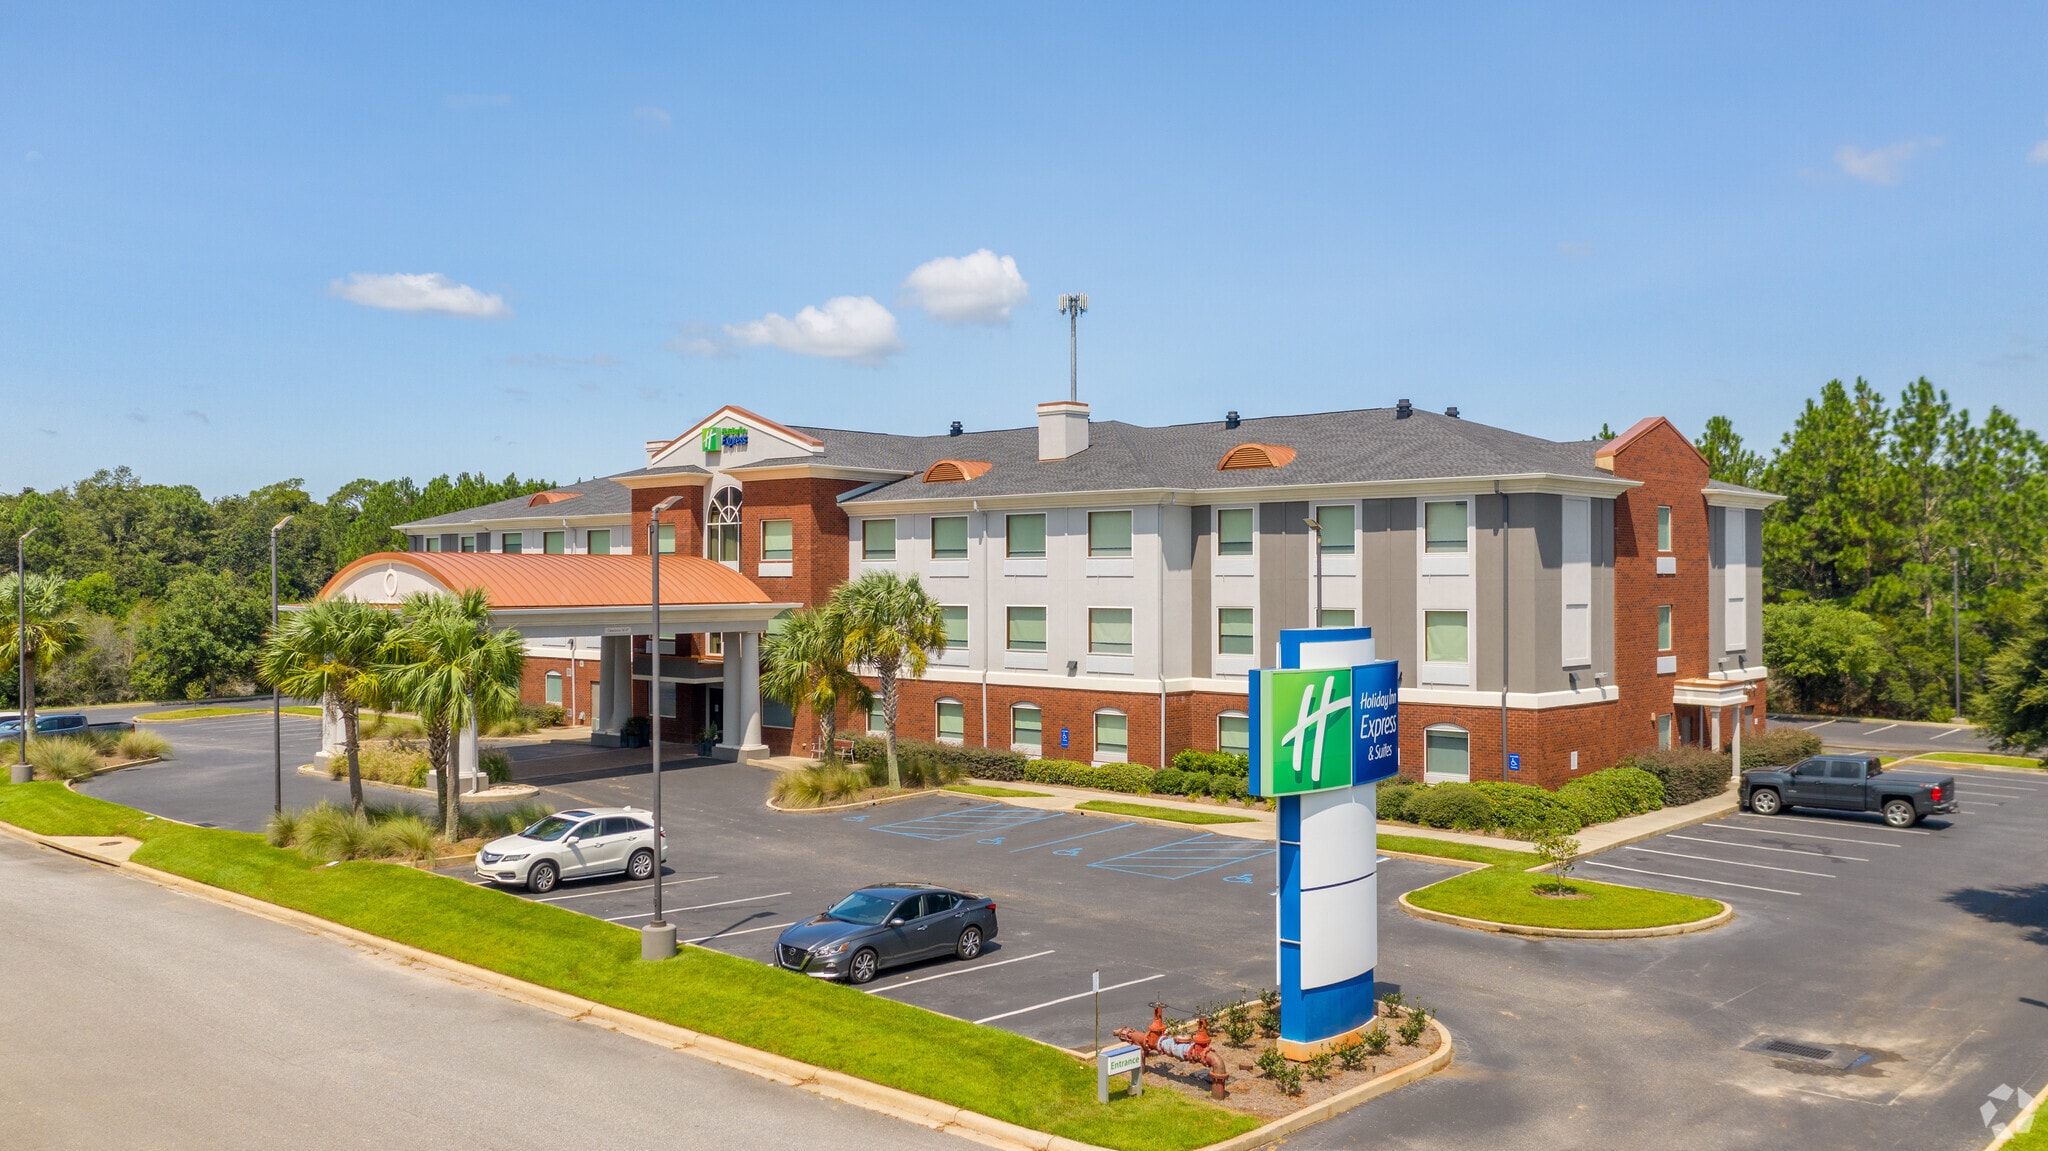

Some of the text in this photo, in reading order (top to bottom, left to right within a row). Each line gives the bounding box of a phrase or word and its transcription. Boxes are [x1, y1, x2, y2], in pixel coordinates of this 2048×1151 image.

[1360, 688, 1397, 710] Holiday Inn
[1360, 714, 1397, 743] Express
[1368, 743, 1393, 761] & Suites
[1110, 1057, 1140, 1070] Entrance
